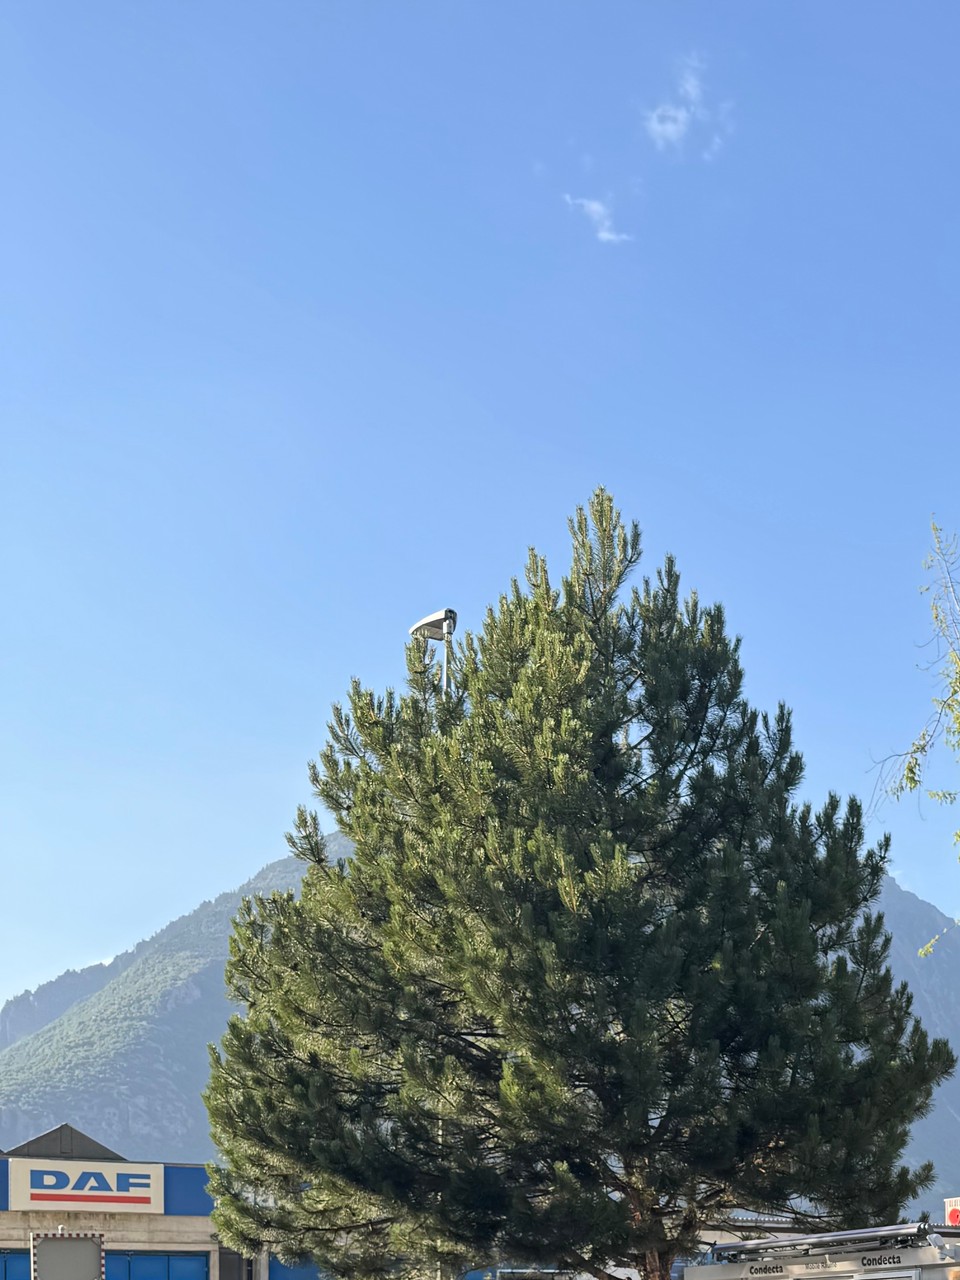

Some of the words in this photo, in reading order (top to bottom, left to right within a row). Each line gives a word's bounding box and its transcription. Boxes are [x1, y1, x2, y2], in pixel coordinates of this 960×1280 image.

[30, 1169, 151, 1193] DAF
[861, 1254, 902, 1267] Condecta
[749, 1264, 784, 1275] Condecta
